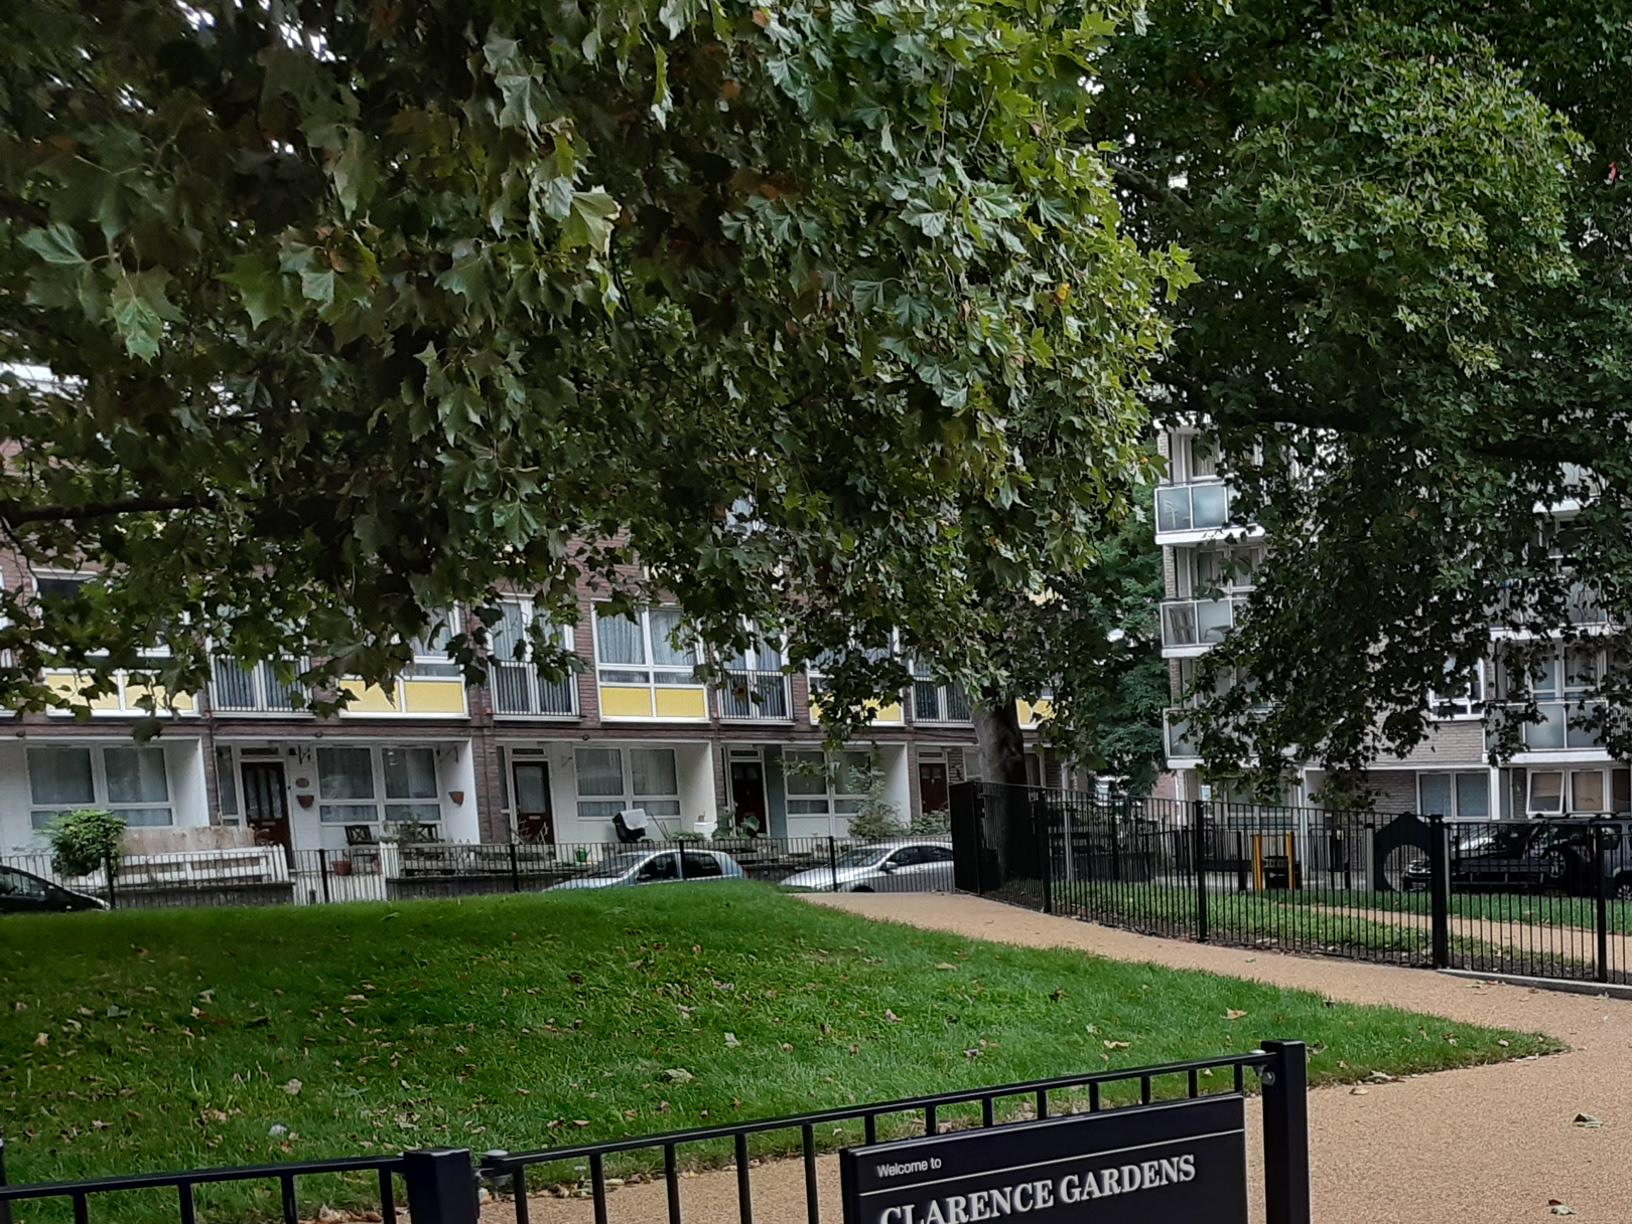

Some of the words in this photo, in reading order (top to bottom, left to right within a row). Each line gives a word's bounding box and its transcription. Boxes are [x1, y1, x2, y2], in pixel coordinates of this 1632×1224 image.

[877, 1160, 928, 1178] Welcome
[930, 1157, 942, 1169] to
[1059, 1155, 1197, 1204] GARDENS
